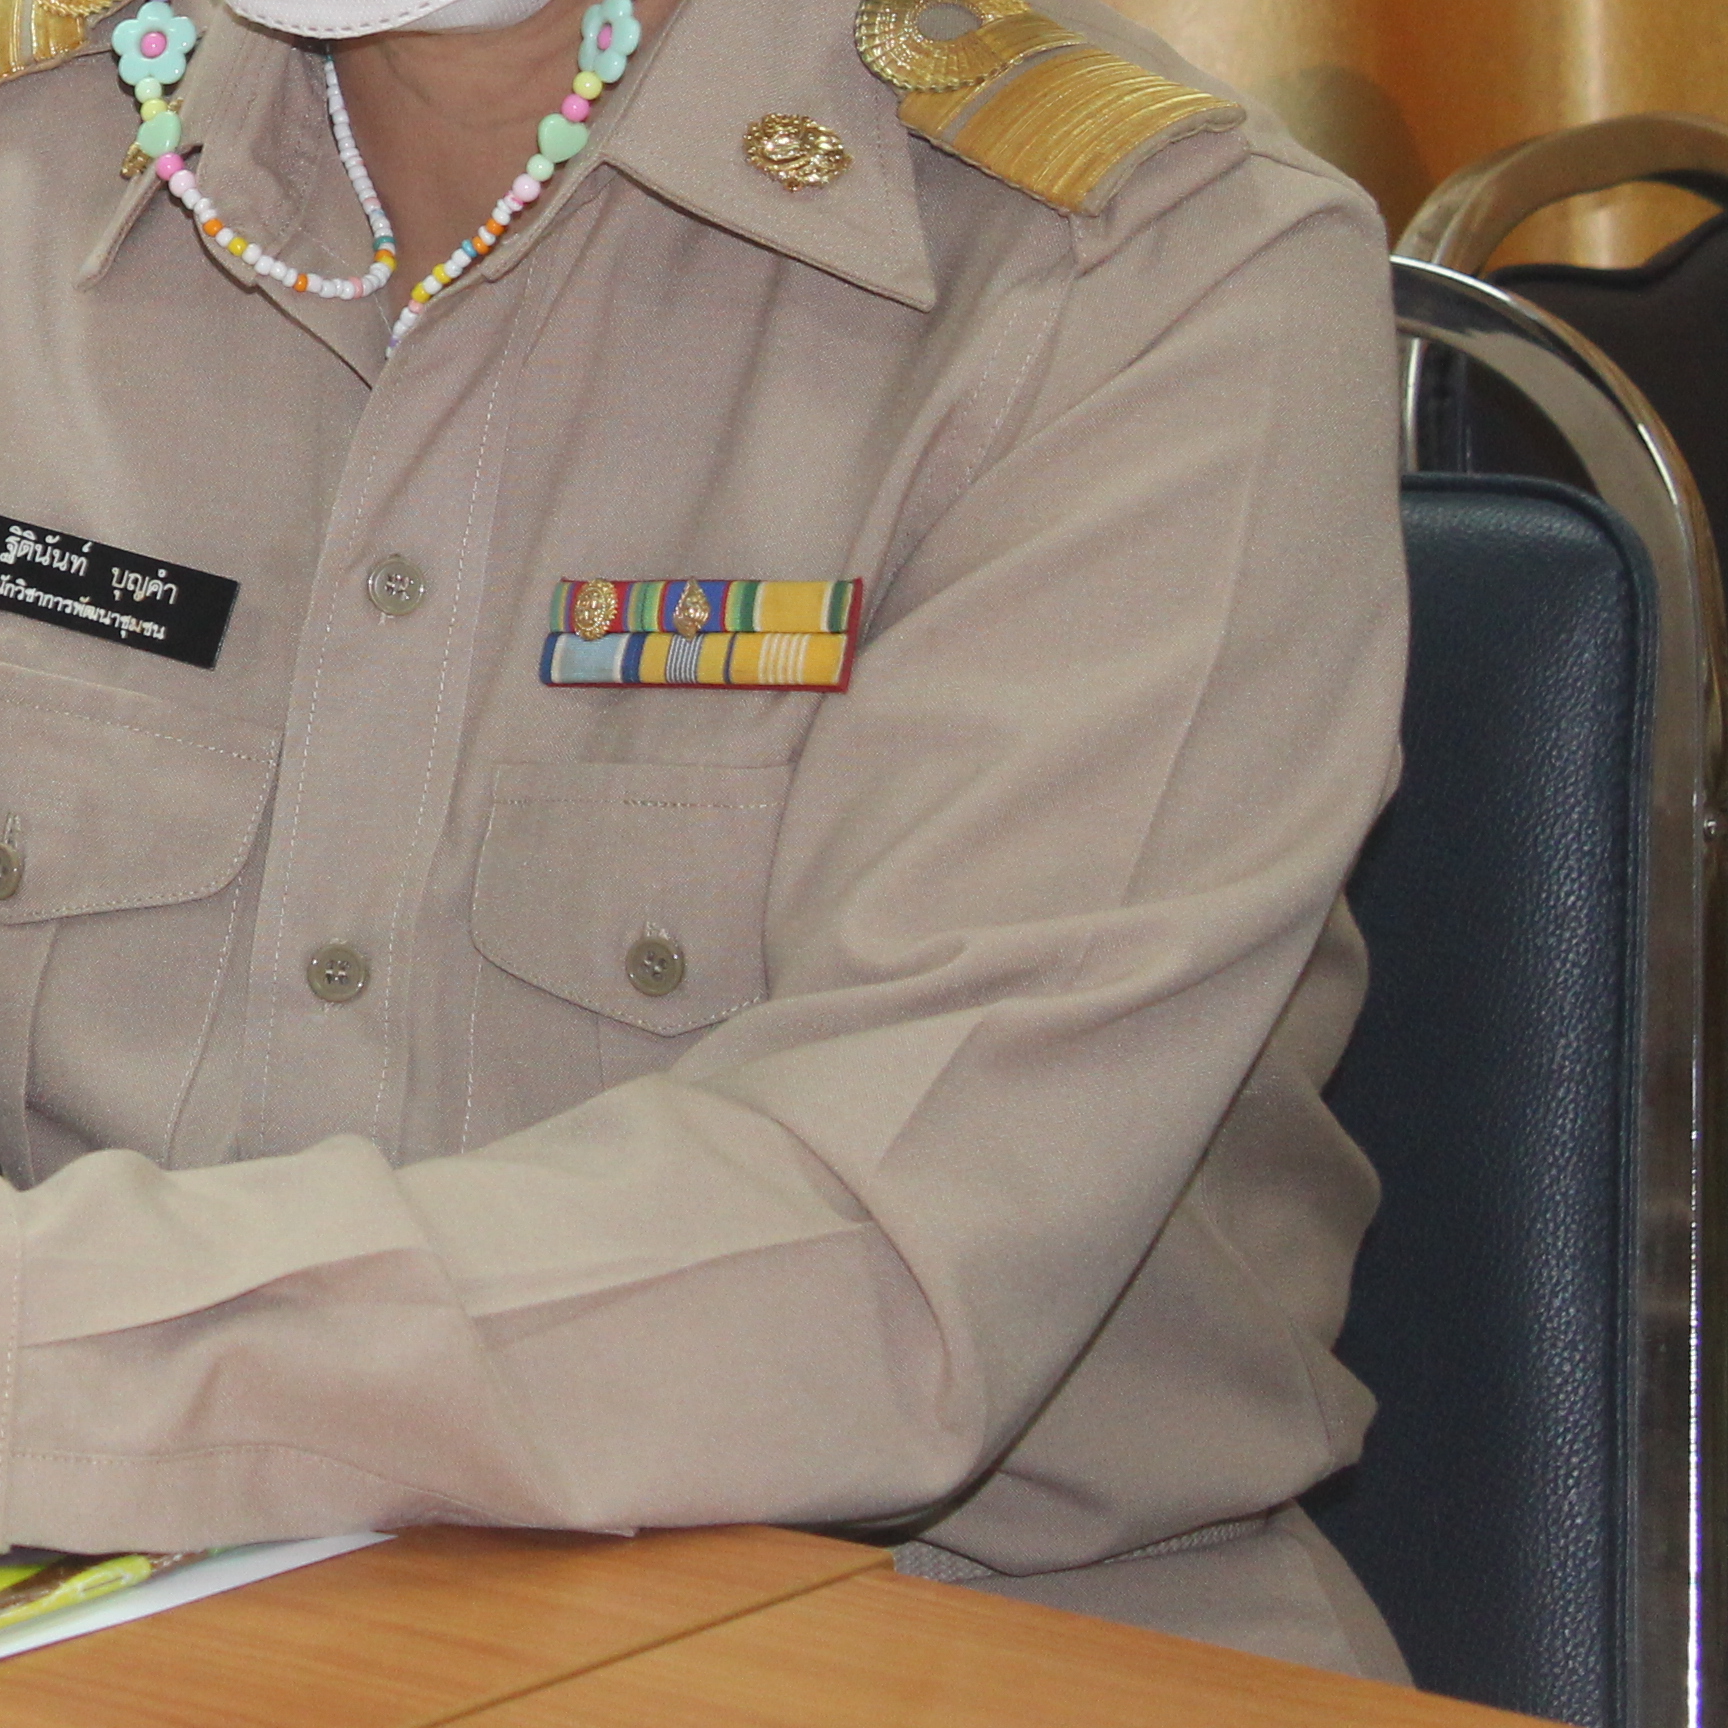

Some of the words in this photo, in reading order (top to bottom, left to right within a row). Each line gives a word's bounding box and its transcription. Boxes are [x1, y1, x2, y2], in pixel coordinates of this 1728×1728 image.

[0, 525, 93, 577] ฐิตินันท์
[111, 568, 180, 605] บุญคำ
